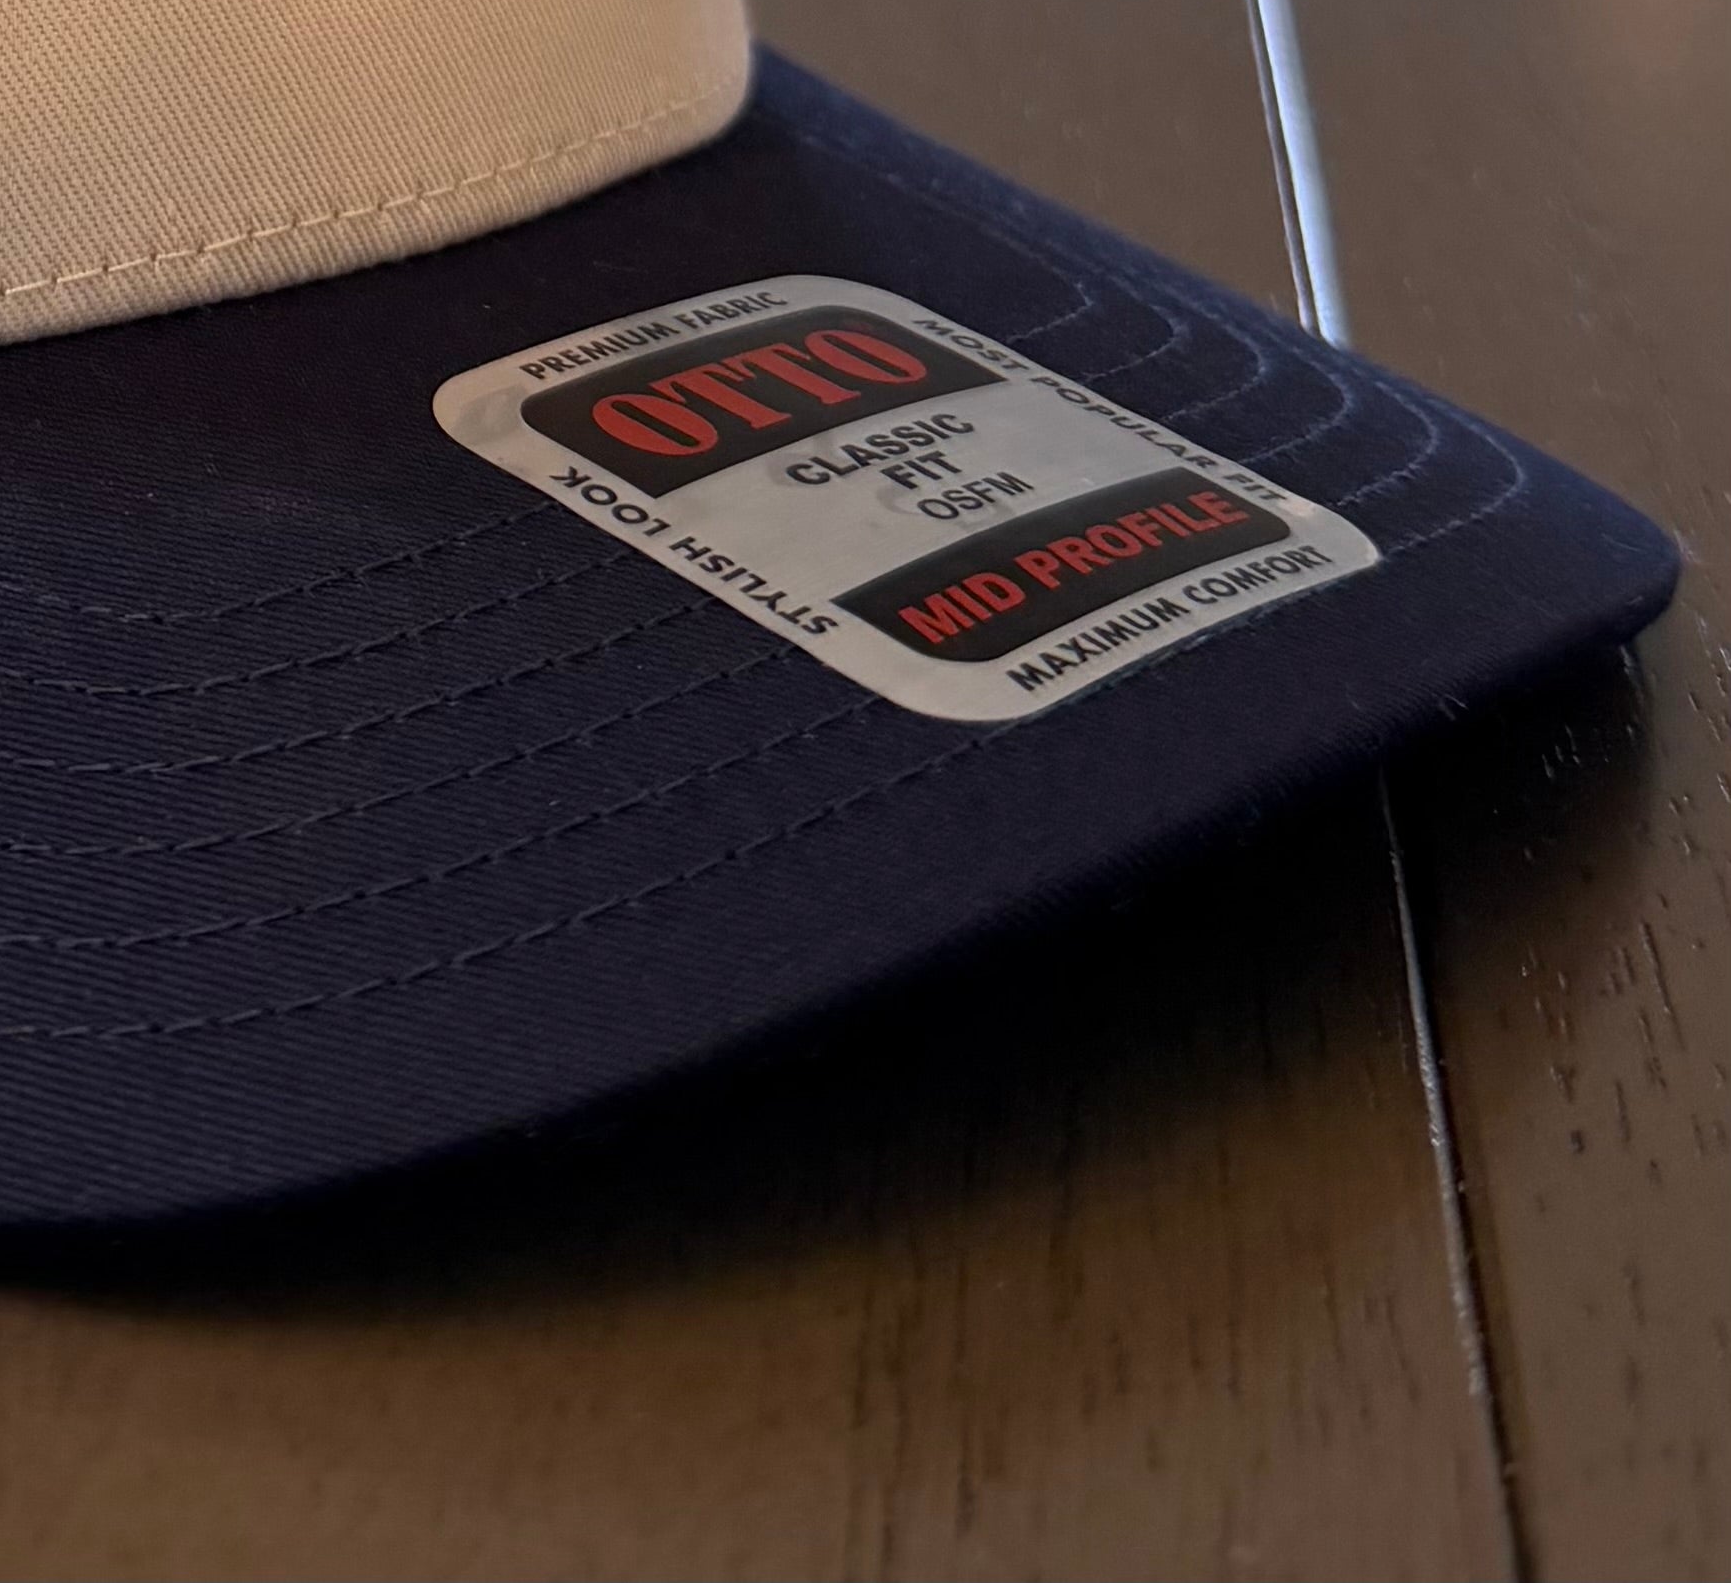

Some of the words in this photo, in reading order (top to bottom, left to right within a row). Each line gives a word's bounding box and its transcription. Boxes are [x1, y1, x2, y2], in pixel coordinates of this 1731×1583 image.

[519, 320, 679, 380] PREMIUM
[677, 291, 788, 330] FABRIC
[592, 330, 927, 456] OTTO
[912, 319, 1031, 371] MOST
[1030, 377, 1219, 469] POPULAR
[1224, 472, 1288, 502] FIT
[787, 414, 974, 484] CLASSIC
[880, 451, 962, 489] FIT
[918, 471, 1034, 519] OSFM
[549, 466, 671, 536] LOOK
[669, 536, 839, 635] STYLISH
[898, 572, 1026, 644] MID
[1013, 490, 1251, 590] PROFILE
[1004, 596, 1190, 691] MAXIMUM
[1182, 545, 1333, 604] COMFORT
